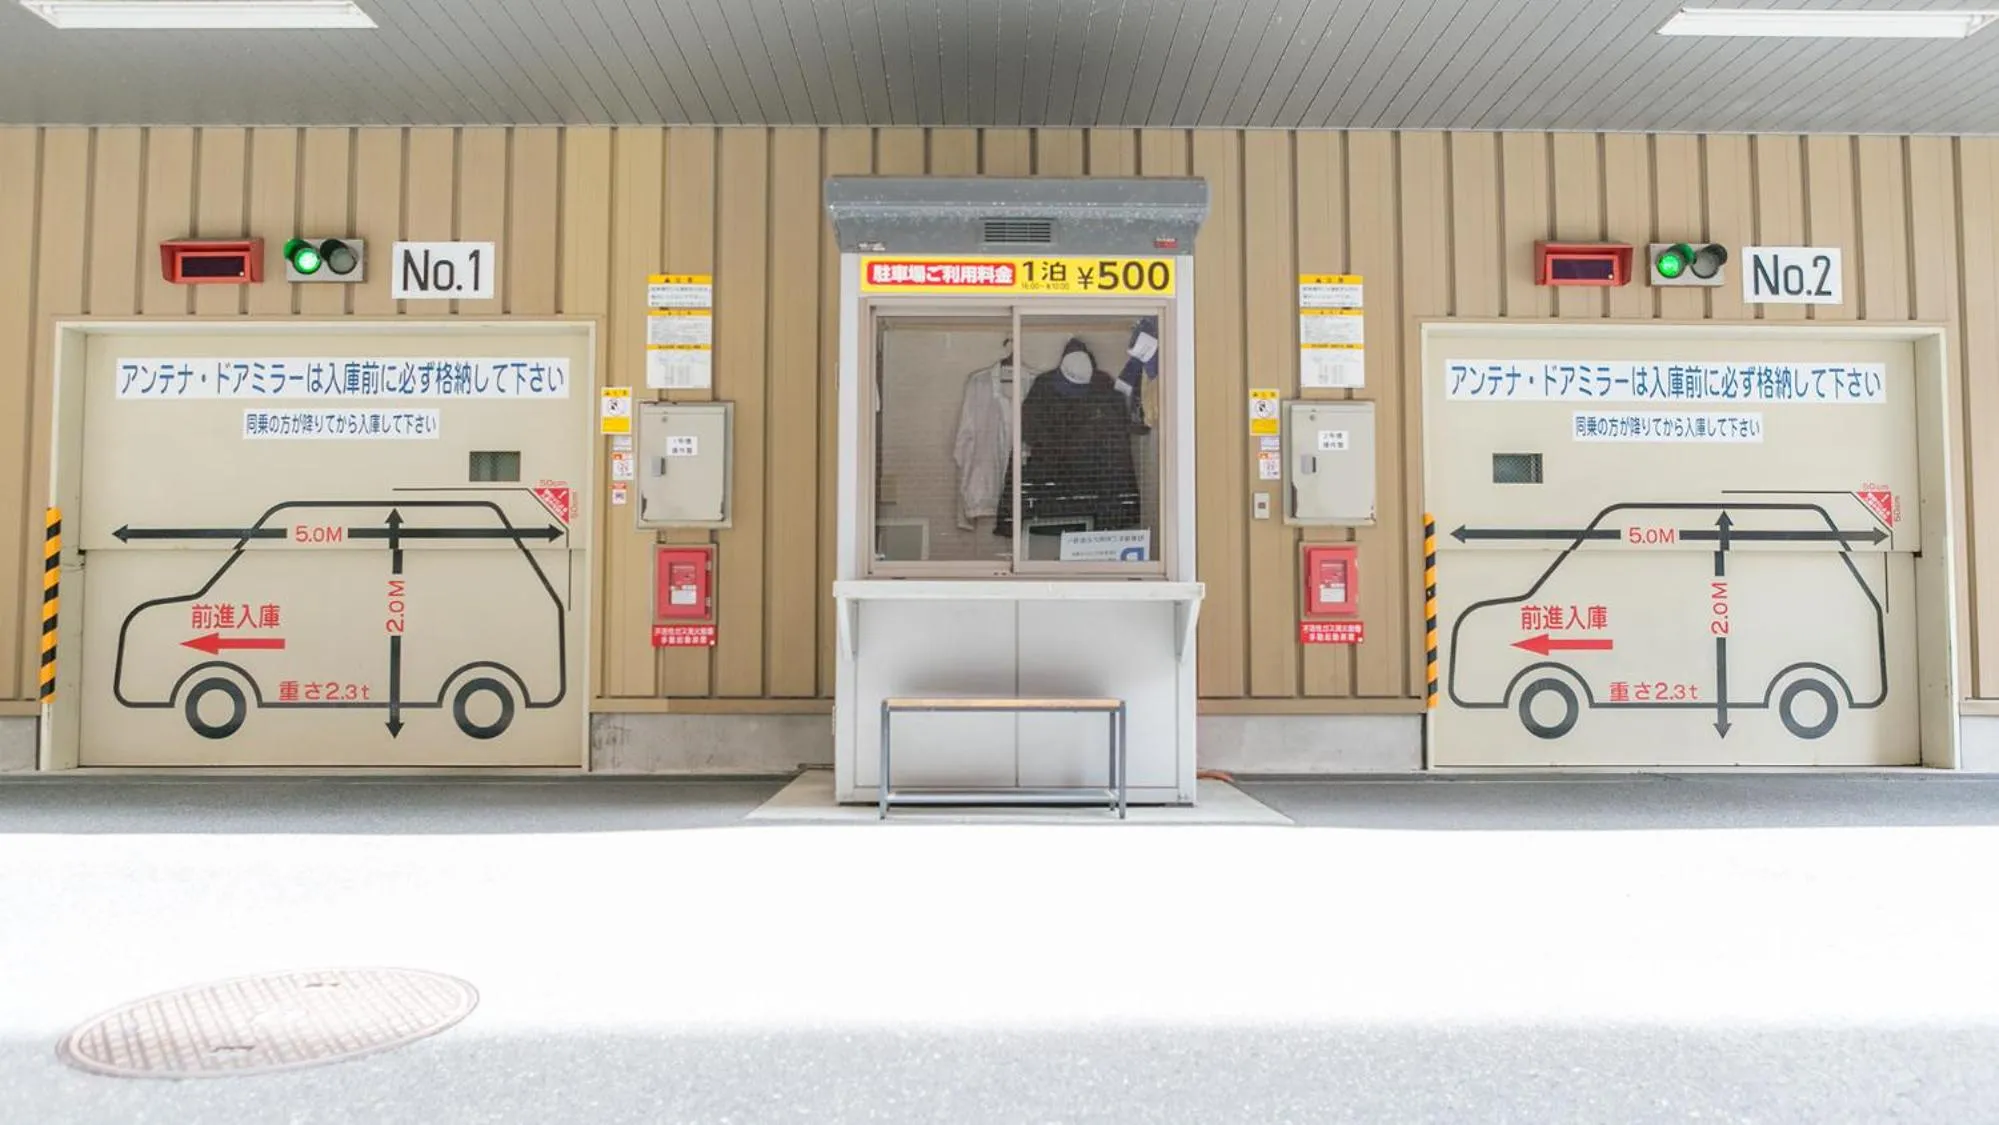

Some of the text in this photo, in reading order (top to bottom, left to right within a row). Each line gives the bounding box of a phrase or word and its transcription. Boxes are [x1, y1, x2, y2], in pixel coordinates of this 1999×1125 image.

[402, 249, 480, 291] No.1
[873, 264, 1012, 284] 駐車場ご利用料金
[1753, 254, 1832, 296] No.2
[121, 361, 564, 395] アンテナ・ドアミラーは入庫前に必ず格納して下さい
[1450, 364, 1881, 400] アンテナ・ドアミラーは入庫前に必ず格納して下さい
[246, 413, 436, 435] 同乗の方が降りてから入庫して下さい
[1575, 415, 1760, 438] 同乗の方が降りてから入庫して下さい
[294, 524, 343, 543] 5.0M
[1628, 527, 1675, 545] 5.0M
[191, 603, 281, 629] 前進入庫
[386, 579, 404, 633] 2.0M
[1520, 605, 1608, 630] 前進入庫
[1711, 582, 1729, 635] 2.0M
